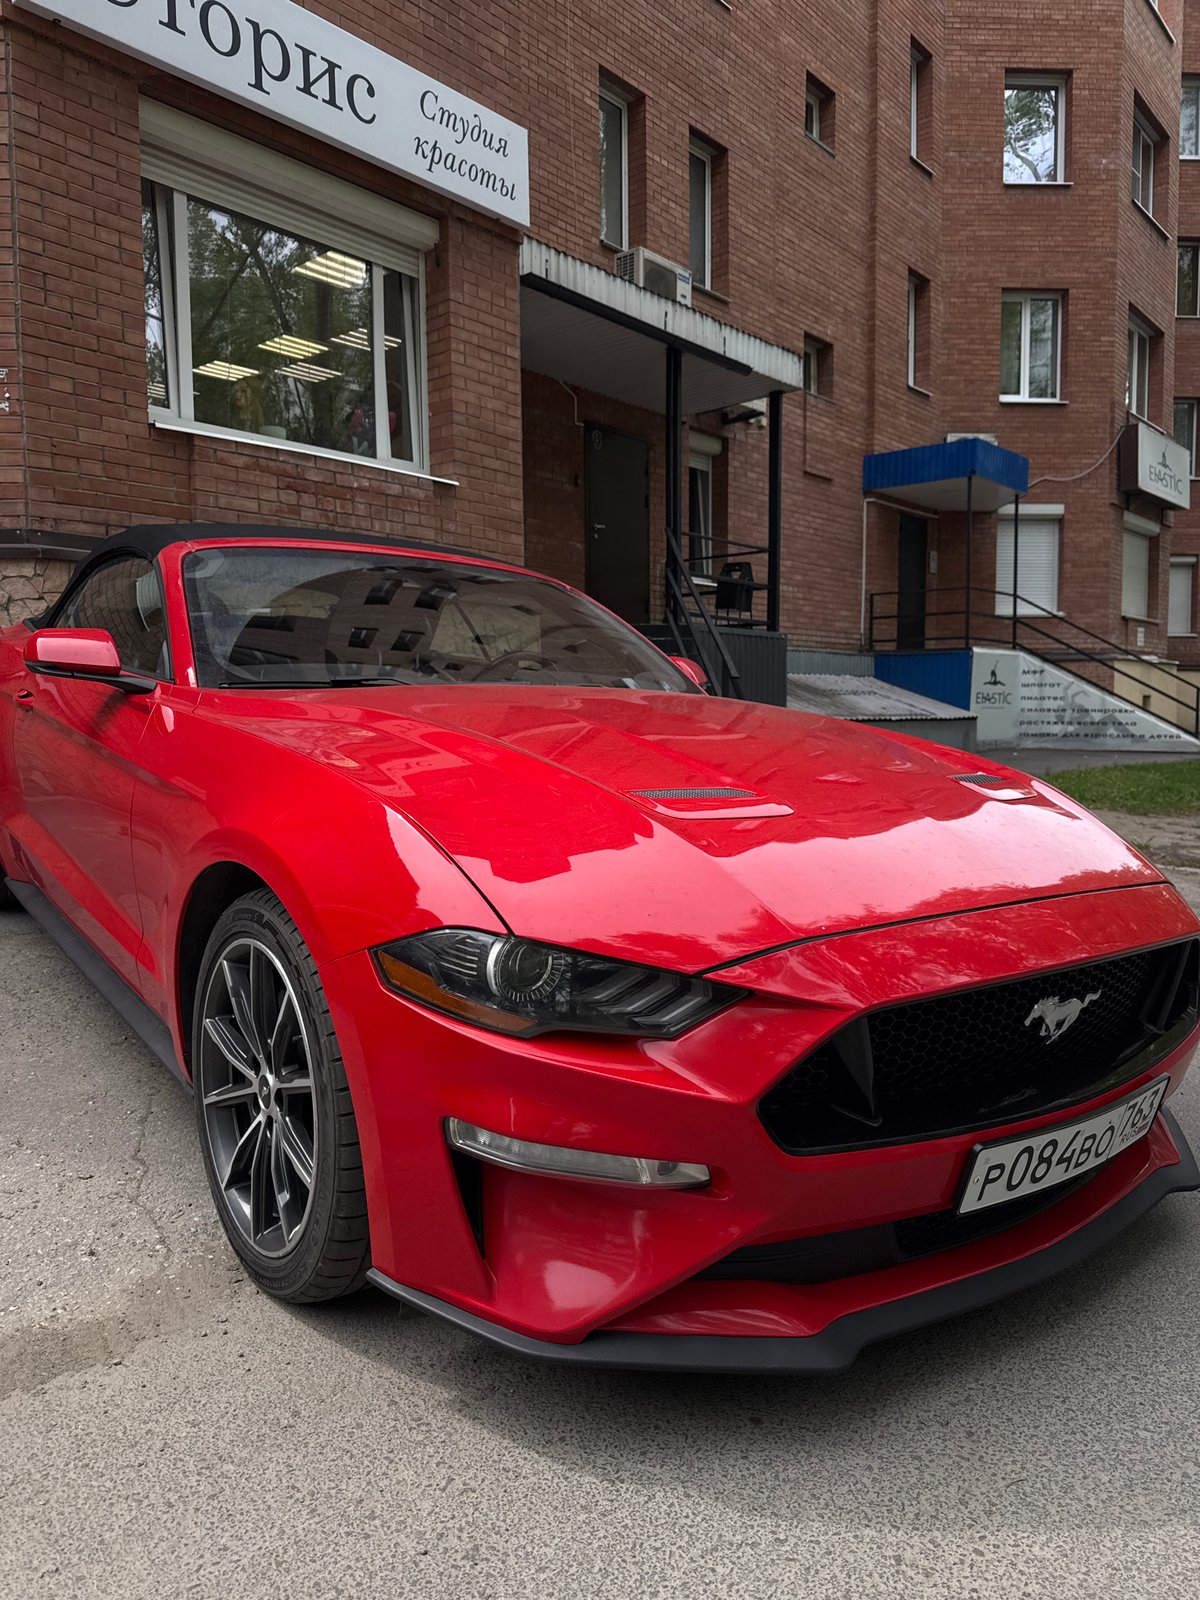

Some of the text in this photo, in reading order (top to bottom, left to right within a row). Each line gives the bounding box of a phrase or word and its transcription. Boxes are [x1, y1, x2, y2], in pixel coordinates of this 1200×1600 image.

[105, 0, 377, 125] торис
[419, 89, 509, 158] Студия
[413, 136, 517, 201] красоты
[1119, 1088, 1161, 1137] 763
[1119, 1126, 1139, 1146] RUS
